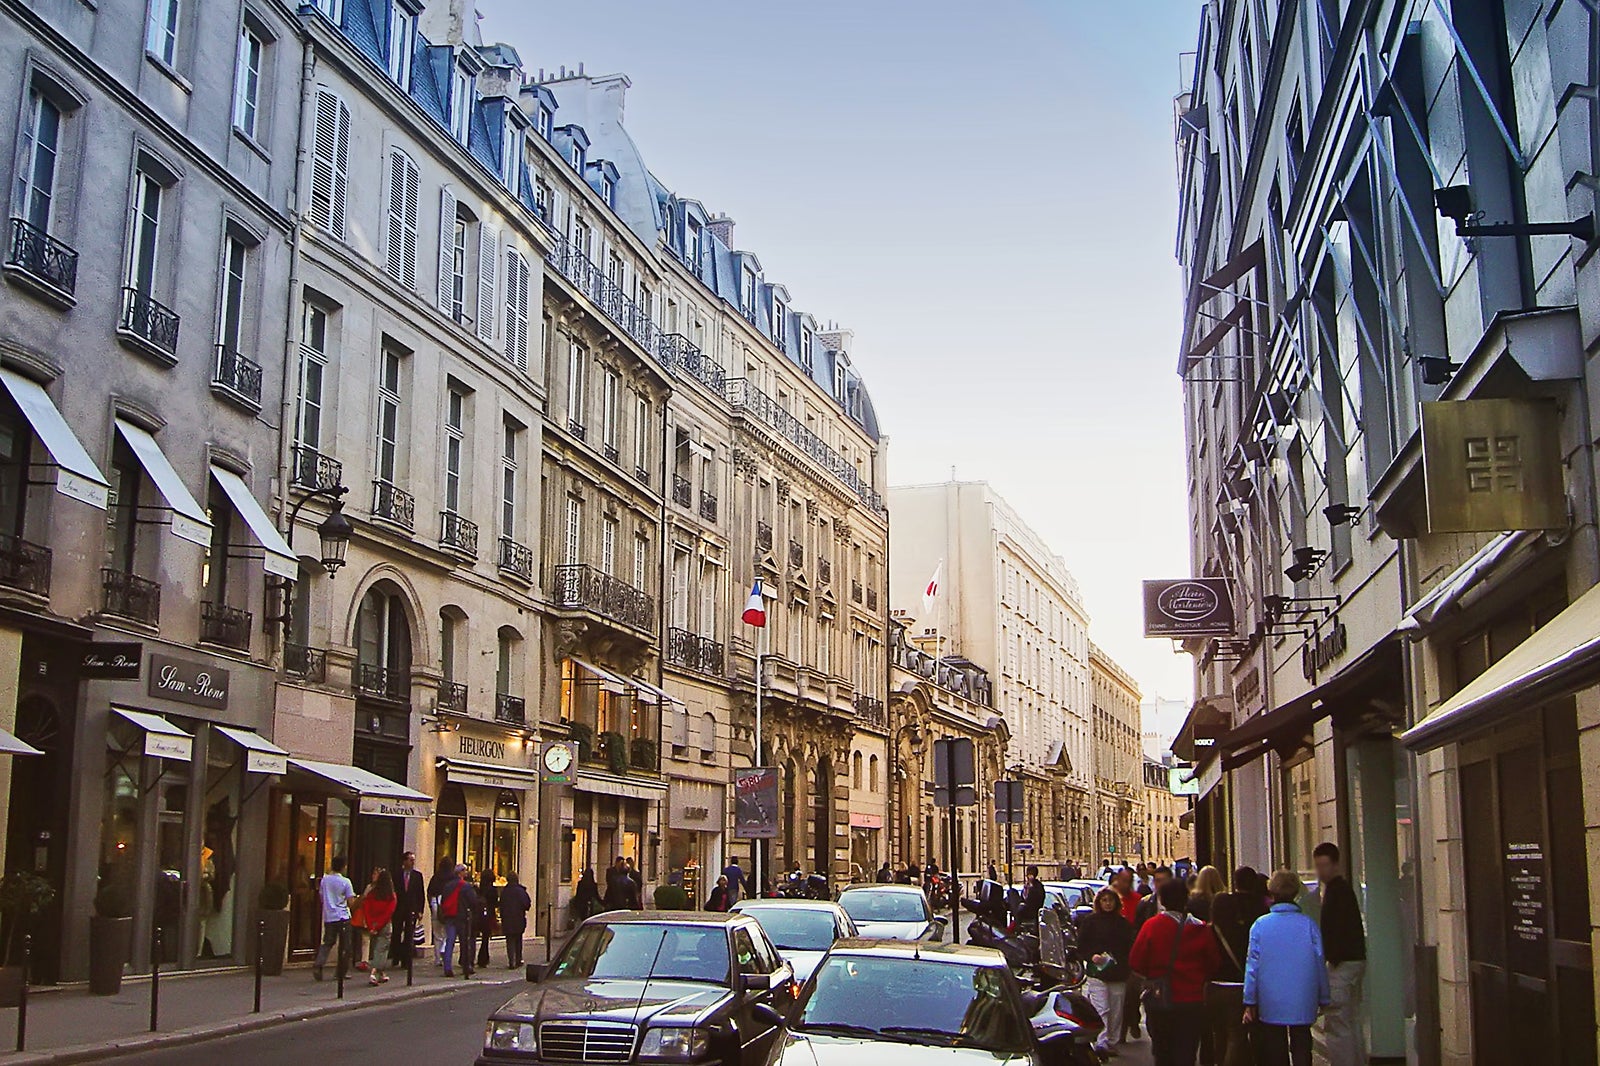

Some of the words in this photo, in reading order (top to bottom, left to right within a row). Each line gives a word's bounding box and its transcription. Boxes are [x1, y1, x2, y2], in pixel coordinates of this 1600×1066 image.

[82, 654, 104, 667] Sam
[158, 665, 186, 692] Sam
[193, 672, 225, 700] Rone
[459, 736, 505, 759] HEURGON
[380, 804, 415, 816] BLANCPAIN
